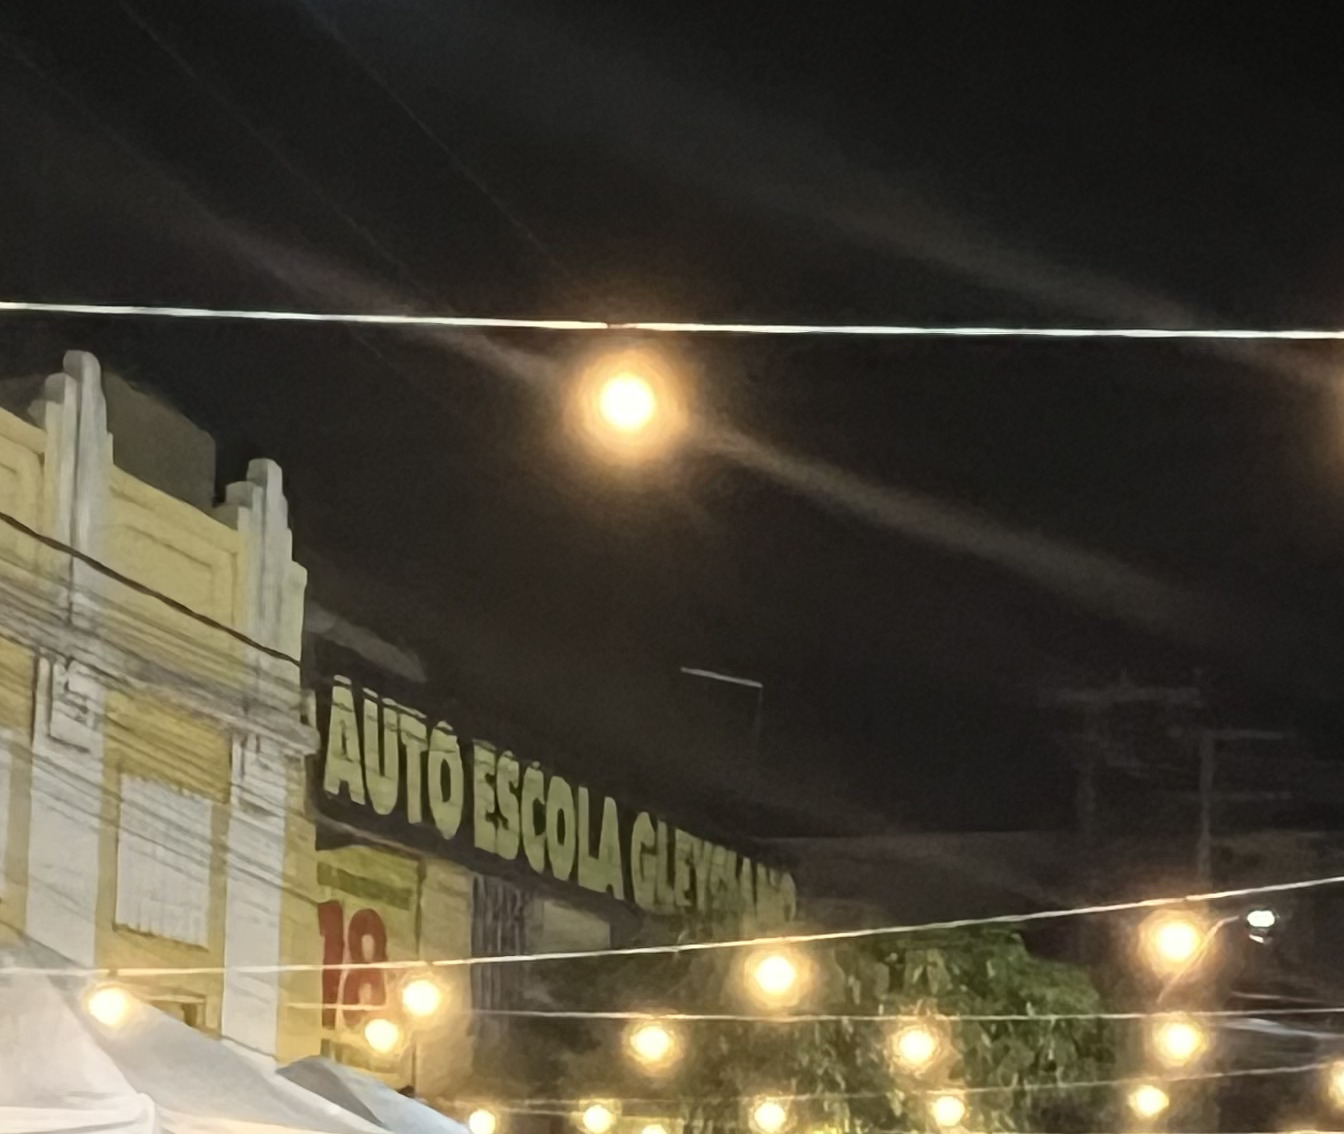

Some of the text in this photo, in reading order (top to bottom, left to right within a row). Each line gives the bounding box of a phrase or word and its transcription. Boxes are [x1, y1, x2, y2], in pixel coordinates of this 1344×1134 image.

[323, 674, 464, 840] AUTO
[471, 738, 625, 900] ESCOLA
[317, 899, 387, 1032] 18
